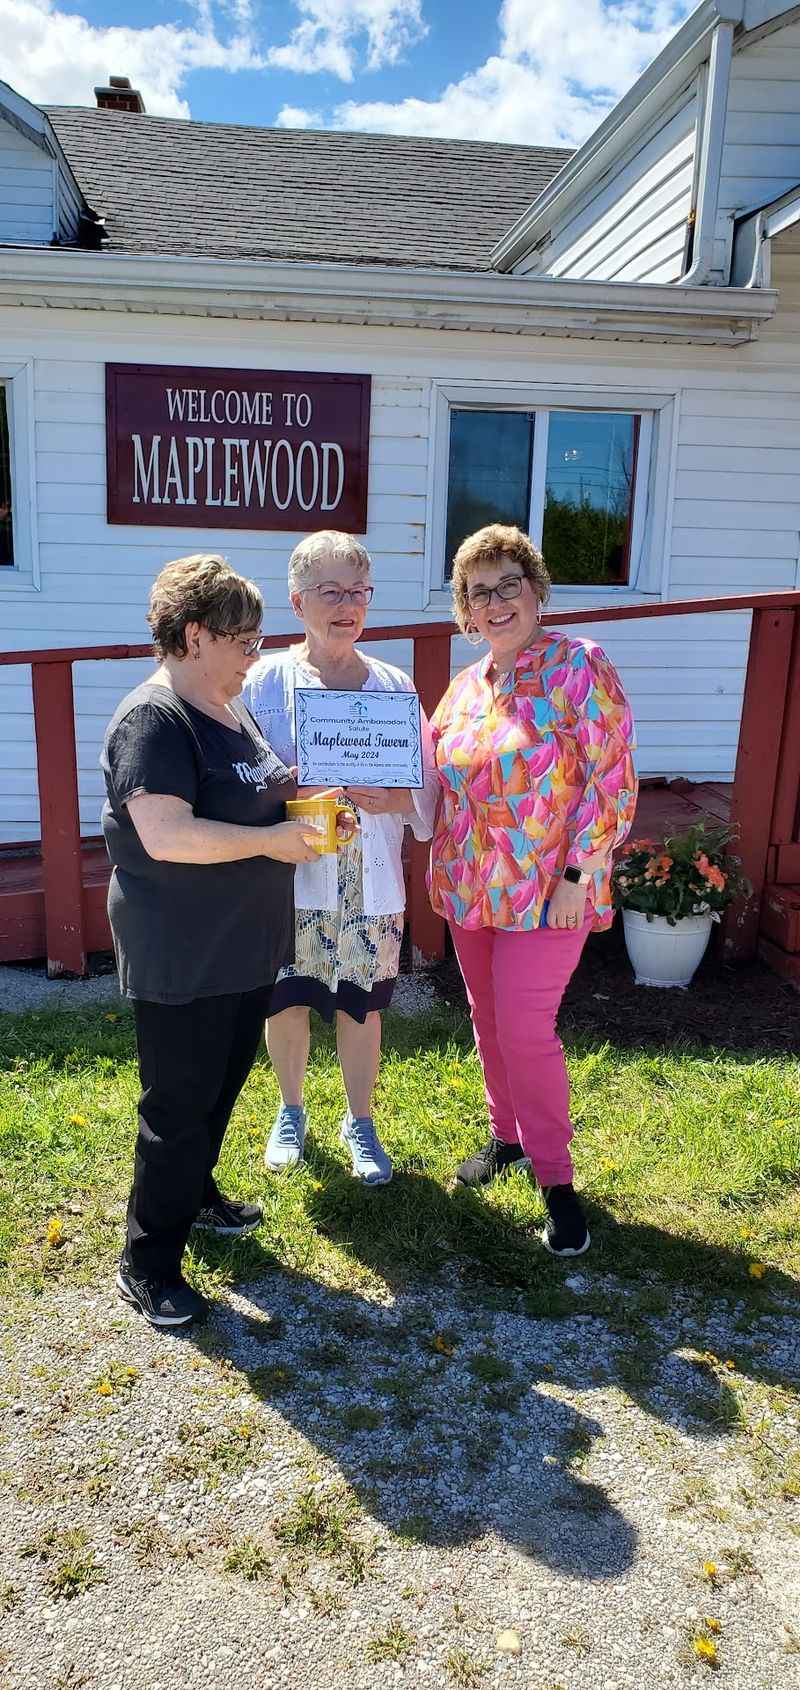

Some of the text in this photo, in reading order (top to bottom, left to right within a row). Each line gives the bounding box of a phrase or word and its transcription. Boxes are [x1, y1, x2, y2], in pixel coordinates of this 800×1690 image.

[166, 388, 313, 428] WELCOME TO
[131, 434, 345, 512] MAPLEWOOD
[309, 716, 406, 726] Community Ambassadors
[309, 731, 409, 751] Maplewood Tavern
[340, 751, 380, 760] May 2024
